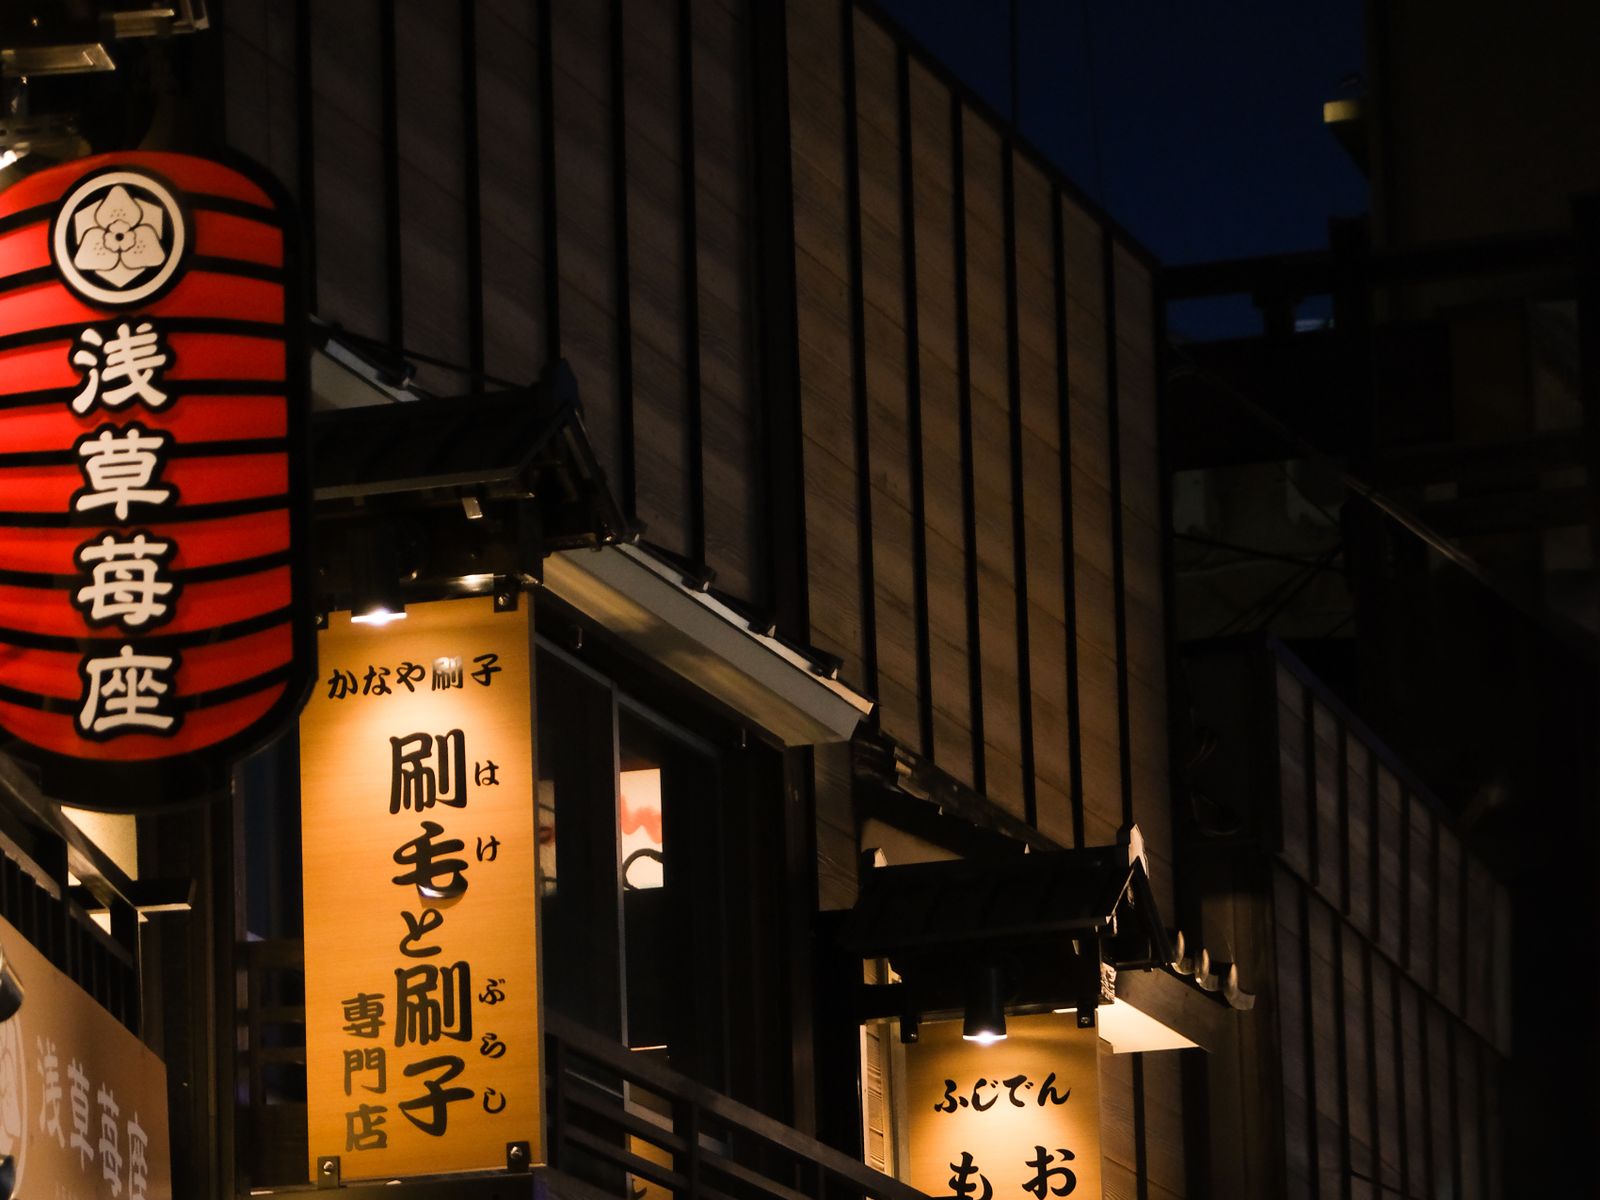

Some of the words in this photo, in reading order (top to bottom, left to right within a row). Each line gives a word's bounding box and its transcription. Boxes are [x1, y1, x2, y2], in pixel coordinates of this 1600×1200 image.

[72, 322, 174, 732] 浅草苺座
[327, 653, 502, 700] かなや刷子
[389, 728, 475, 1137] 刷毛と刷子
[343, 991, 388, 1153] 専門店
[934, 1072, 1072, 1114] ふじでん
